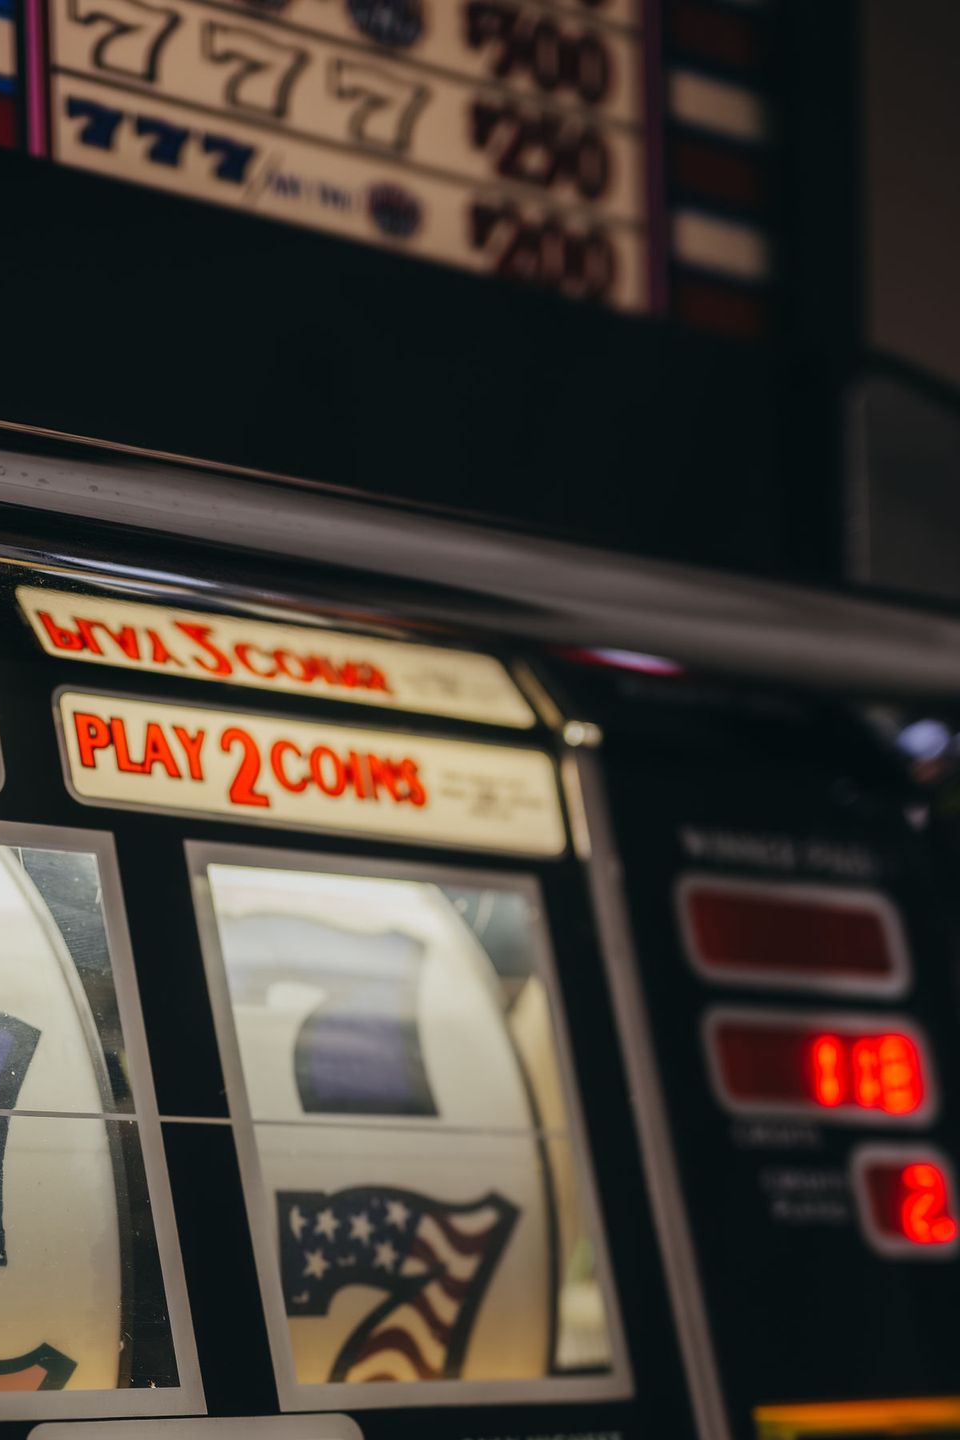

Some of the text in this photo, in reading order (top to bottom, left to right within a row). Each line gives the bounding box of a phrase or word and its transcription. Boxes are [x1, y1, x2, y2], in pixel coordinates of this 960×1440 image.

[73, 711, 207, 781] PLAY
[219, 726, 271, 808] 2
[268, 739, 428, 809] COINS
